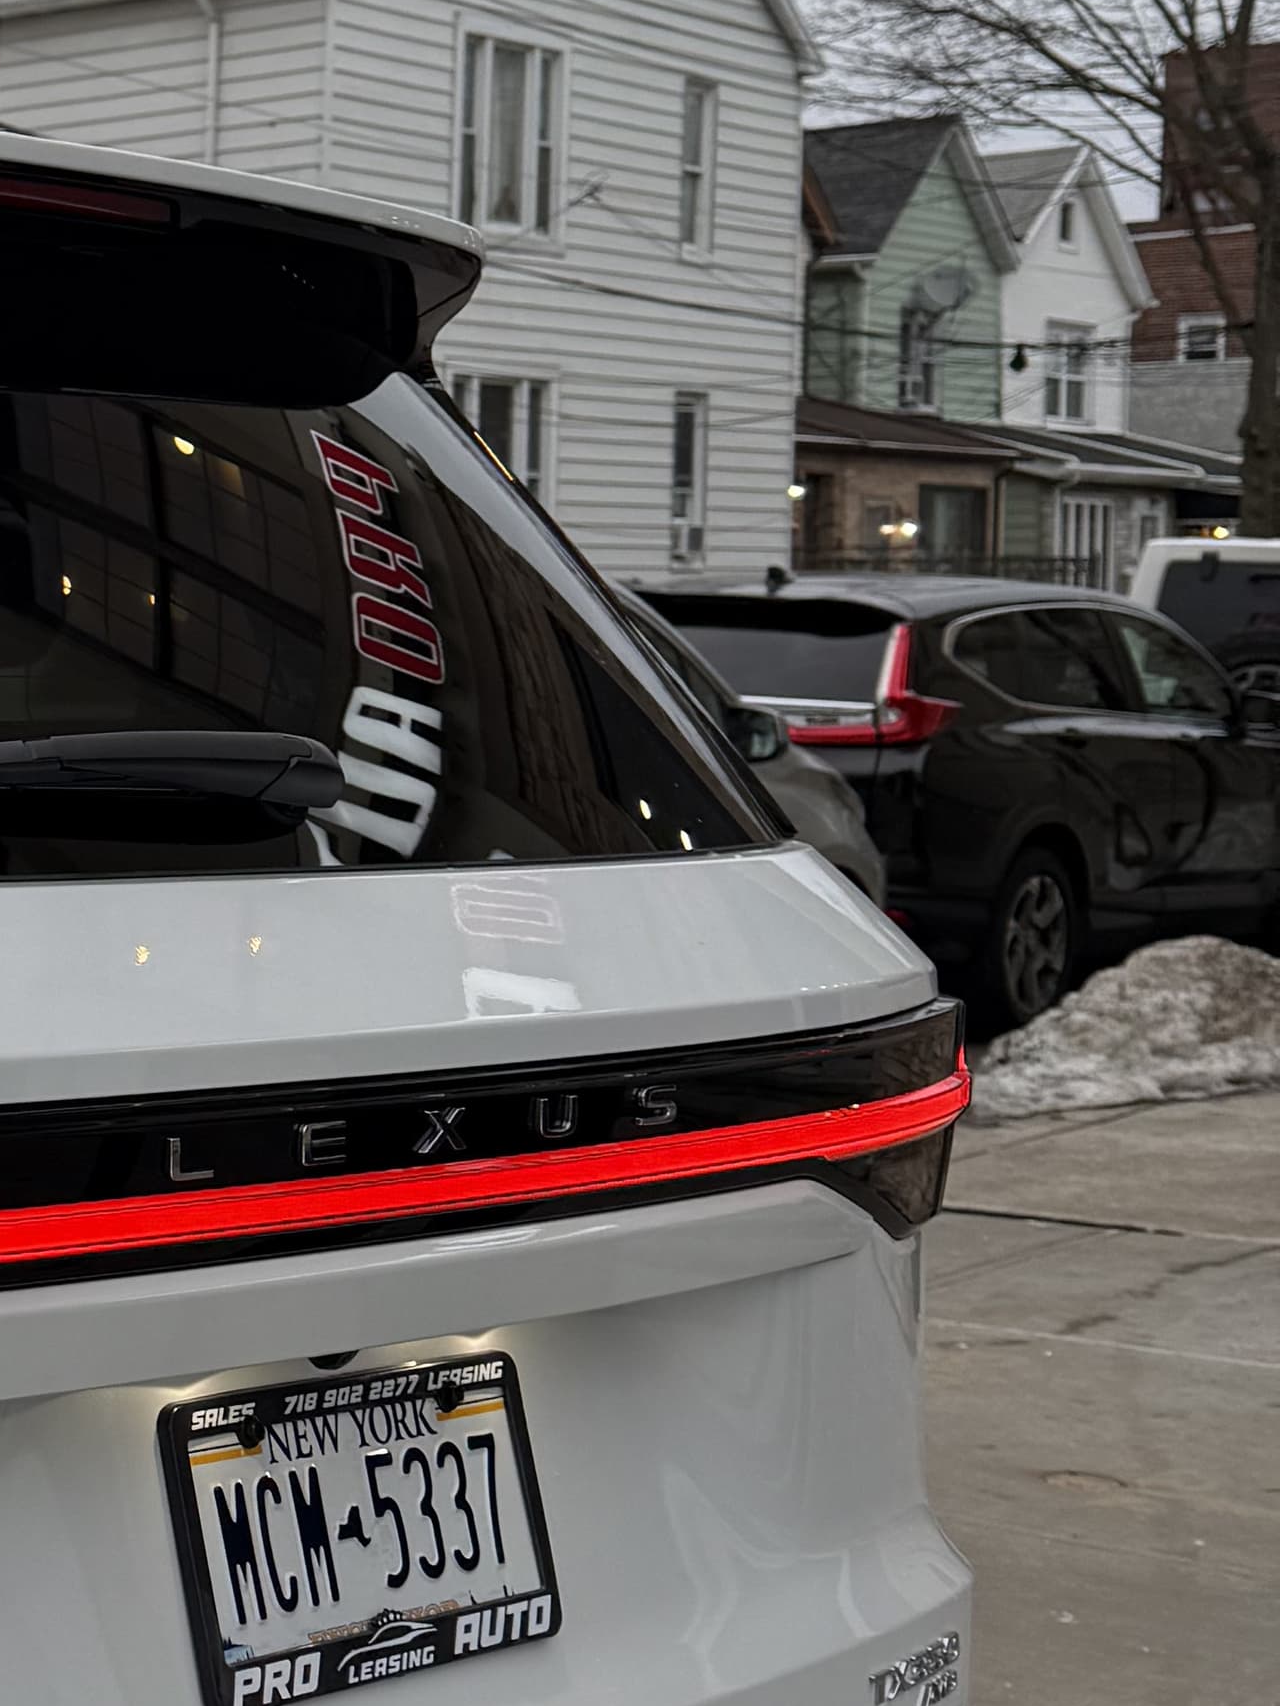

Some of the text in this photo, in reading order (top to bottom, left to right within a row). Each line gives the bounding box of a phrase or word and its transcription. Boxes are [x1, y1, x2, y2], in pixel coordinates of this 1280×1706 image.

[164, 1084, 678, 1183] LEXUS
[191, 1361, 504, 1431] SALES 718 902 2277 LEASING
[264, 1397, 439, 1465] NEW YORK
[213, 1431, 506, 1626] MCM 5337
[348, 1645, 435, 1684] LEASING
[453, 1593, 552, 1655] AUTO
